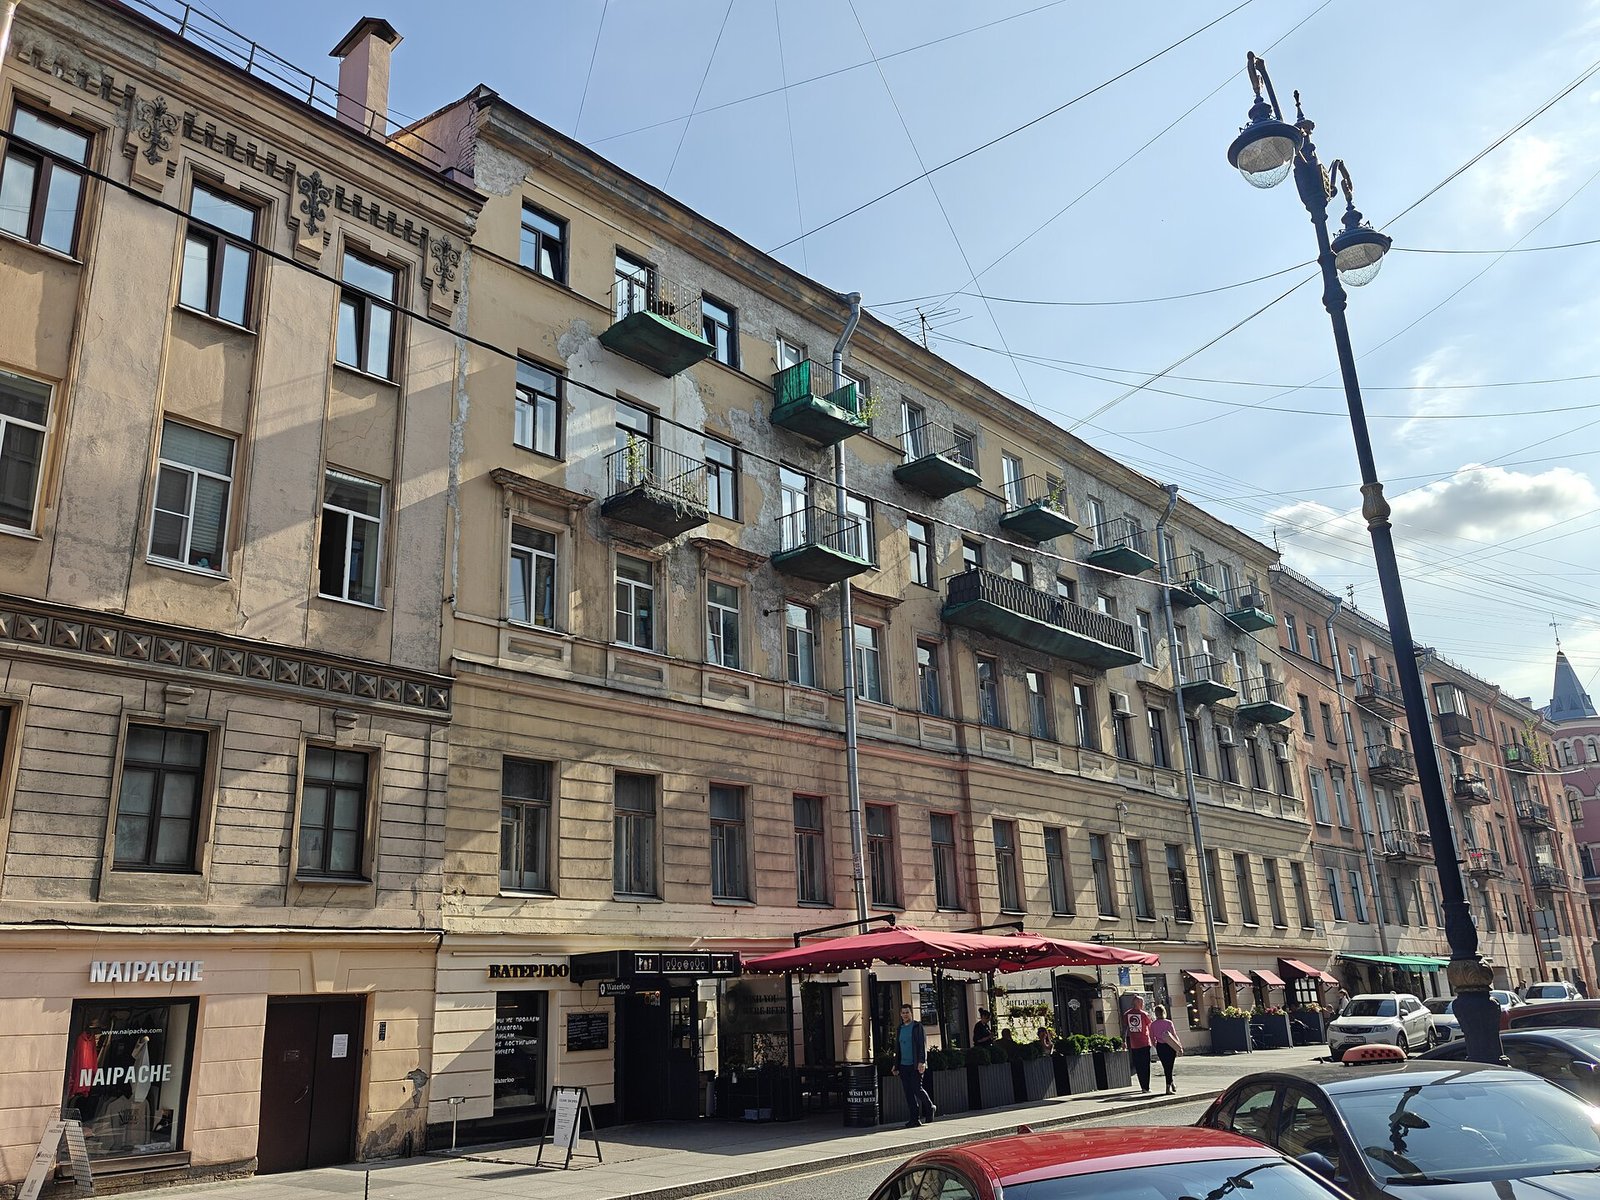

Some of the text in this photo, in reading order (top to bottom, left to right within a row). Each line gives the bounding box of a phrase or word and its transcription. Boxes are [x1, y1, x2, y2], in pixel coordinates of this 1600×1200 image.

[90, 960, 204, 982] NAIPACHE
[488, 964, 569, 978] ВАТЕРЛОО
[101, 1027, 162, 1036] www.naipache.com
[79, 1064, 171, 1087] NAIPACHE
